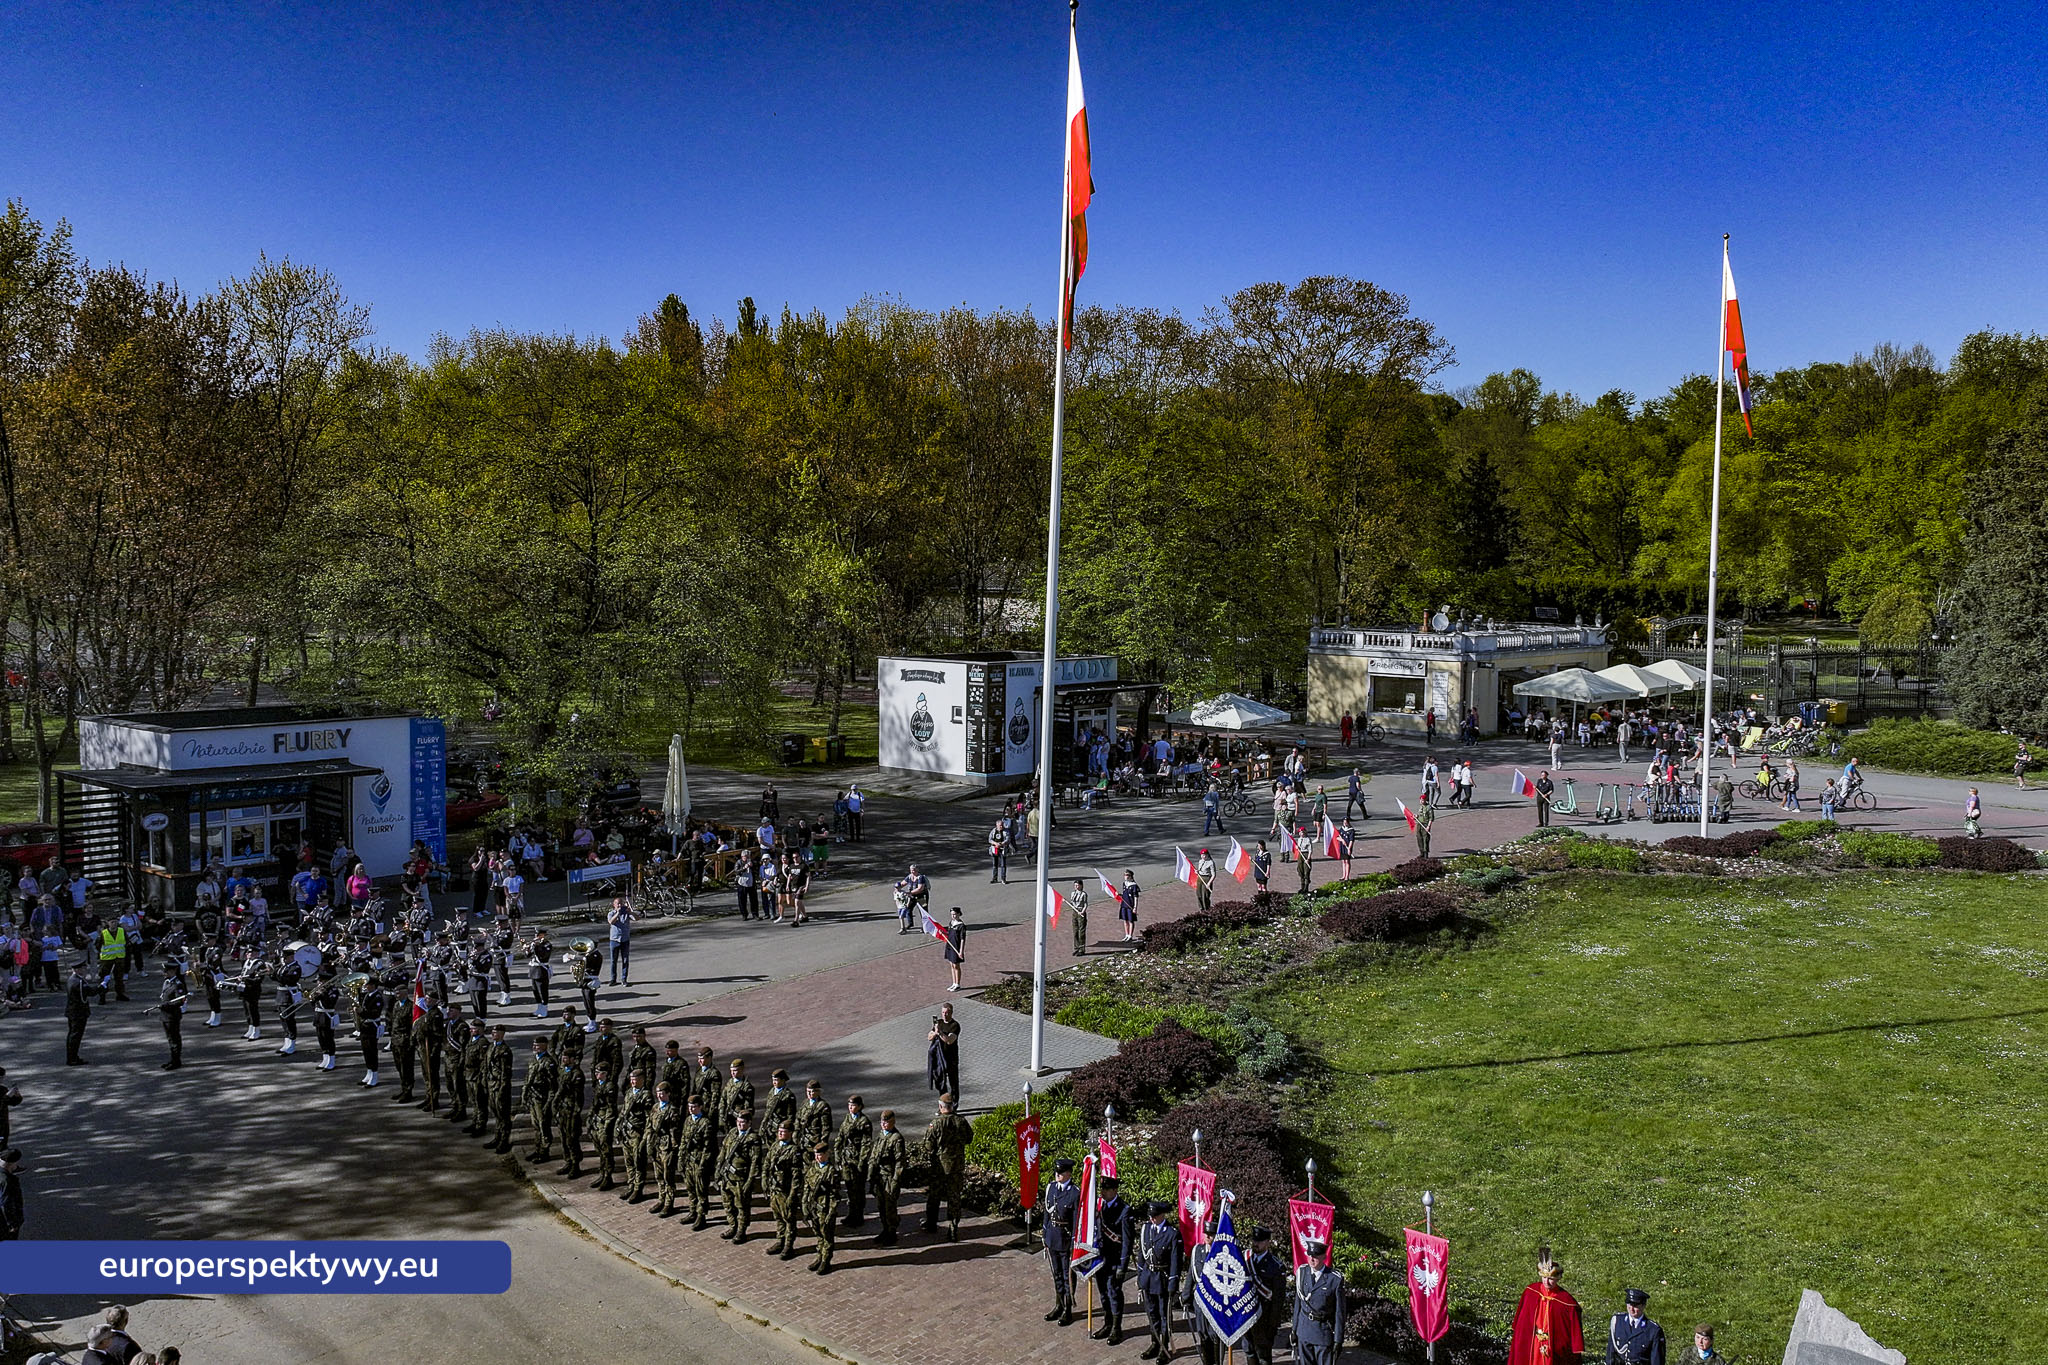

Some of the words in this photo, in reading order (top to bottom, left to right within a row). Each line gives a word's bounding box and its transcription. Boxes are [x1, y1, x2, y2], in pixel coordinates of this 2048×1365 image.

[1061, 659, 1113, 681] LODY
[914, 730, 931, 738] LODY
[182, 739, 268, 758] Naturalnie
[273, 728, 352, 754] FLURRY
[416, 736, 440, 744] FLURRY
[367, 824, 395, 834] FLURRY
